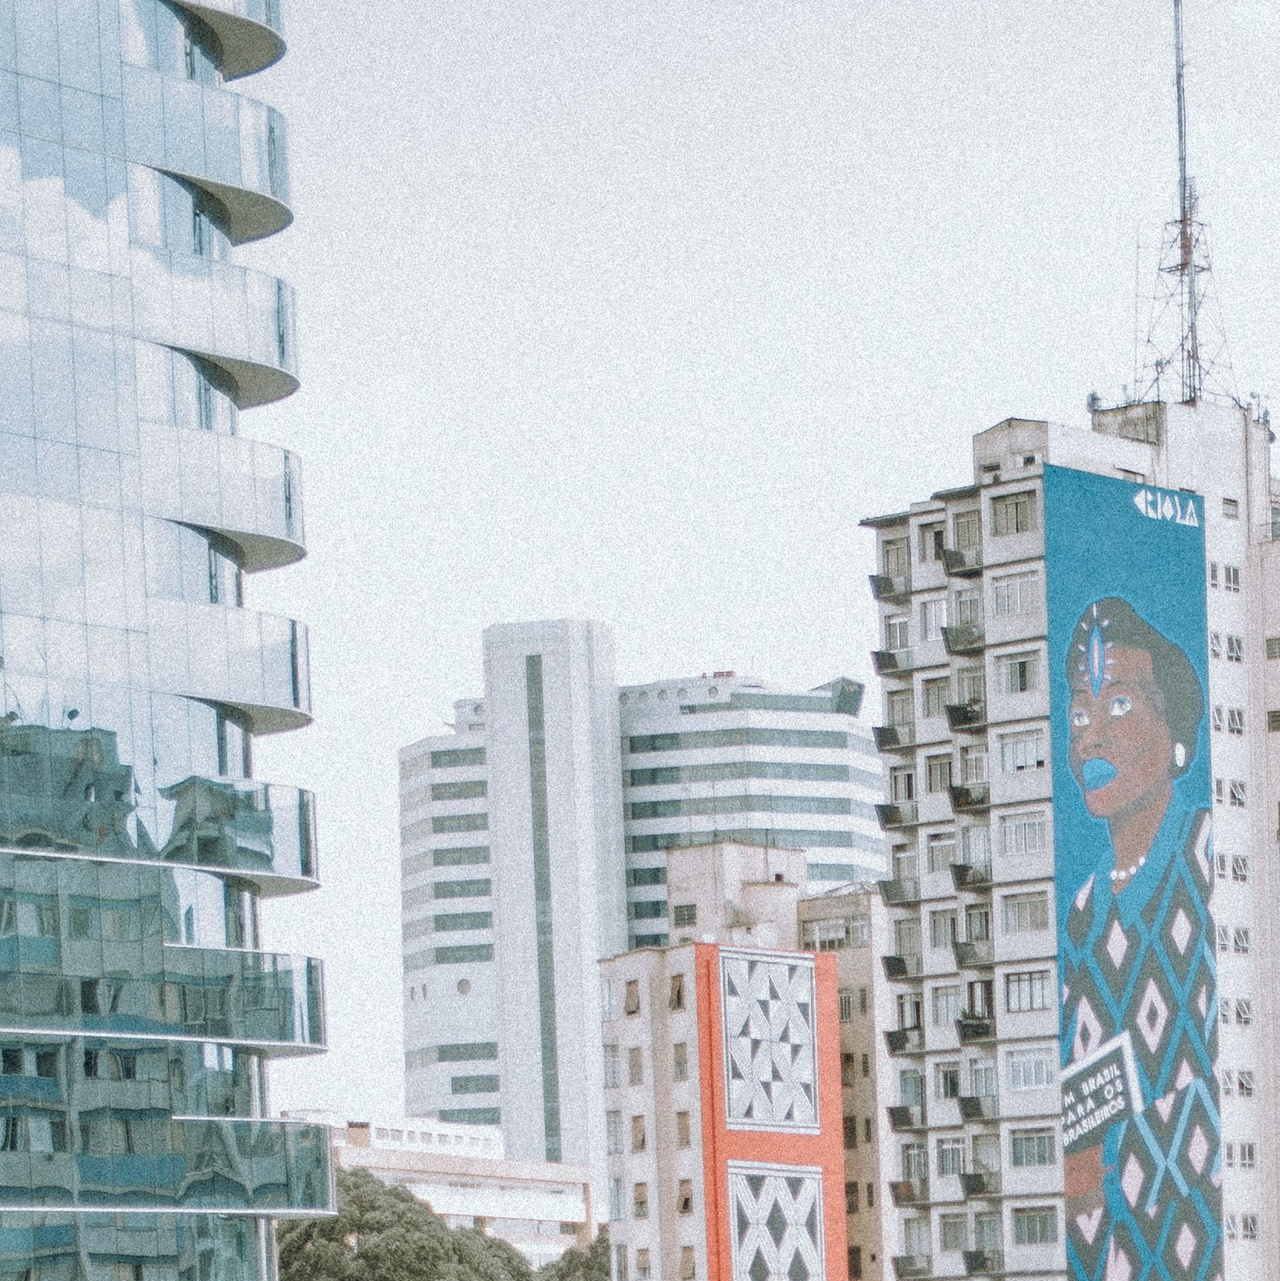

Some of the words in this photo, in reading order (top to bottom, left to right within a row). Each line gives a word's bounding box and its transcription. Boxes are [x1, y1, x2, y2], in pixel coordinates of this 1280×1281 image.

[1133, 489, 1199, 528] CRIOLA
[1082, 1064, 1121, 1095] BRASIL
[1104, 1078, 1123, 1099] OS
[1063, 1096, 1125, 1147] BRASILEIROS
